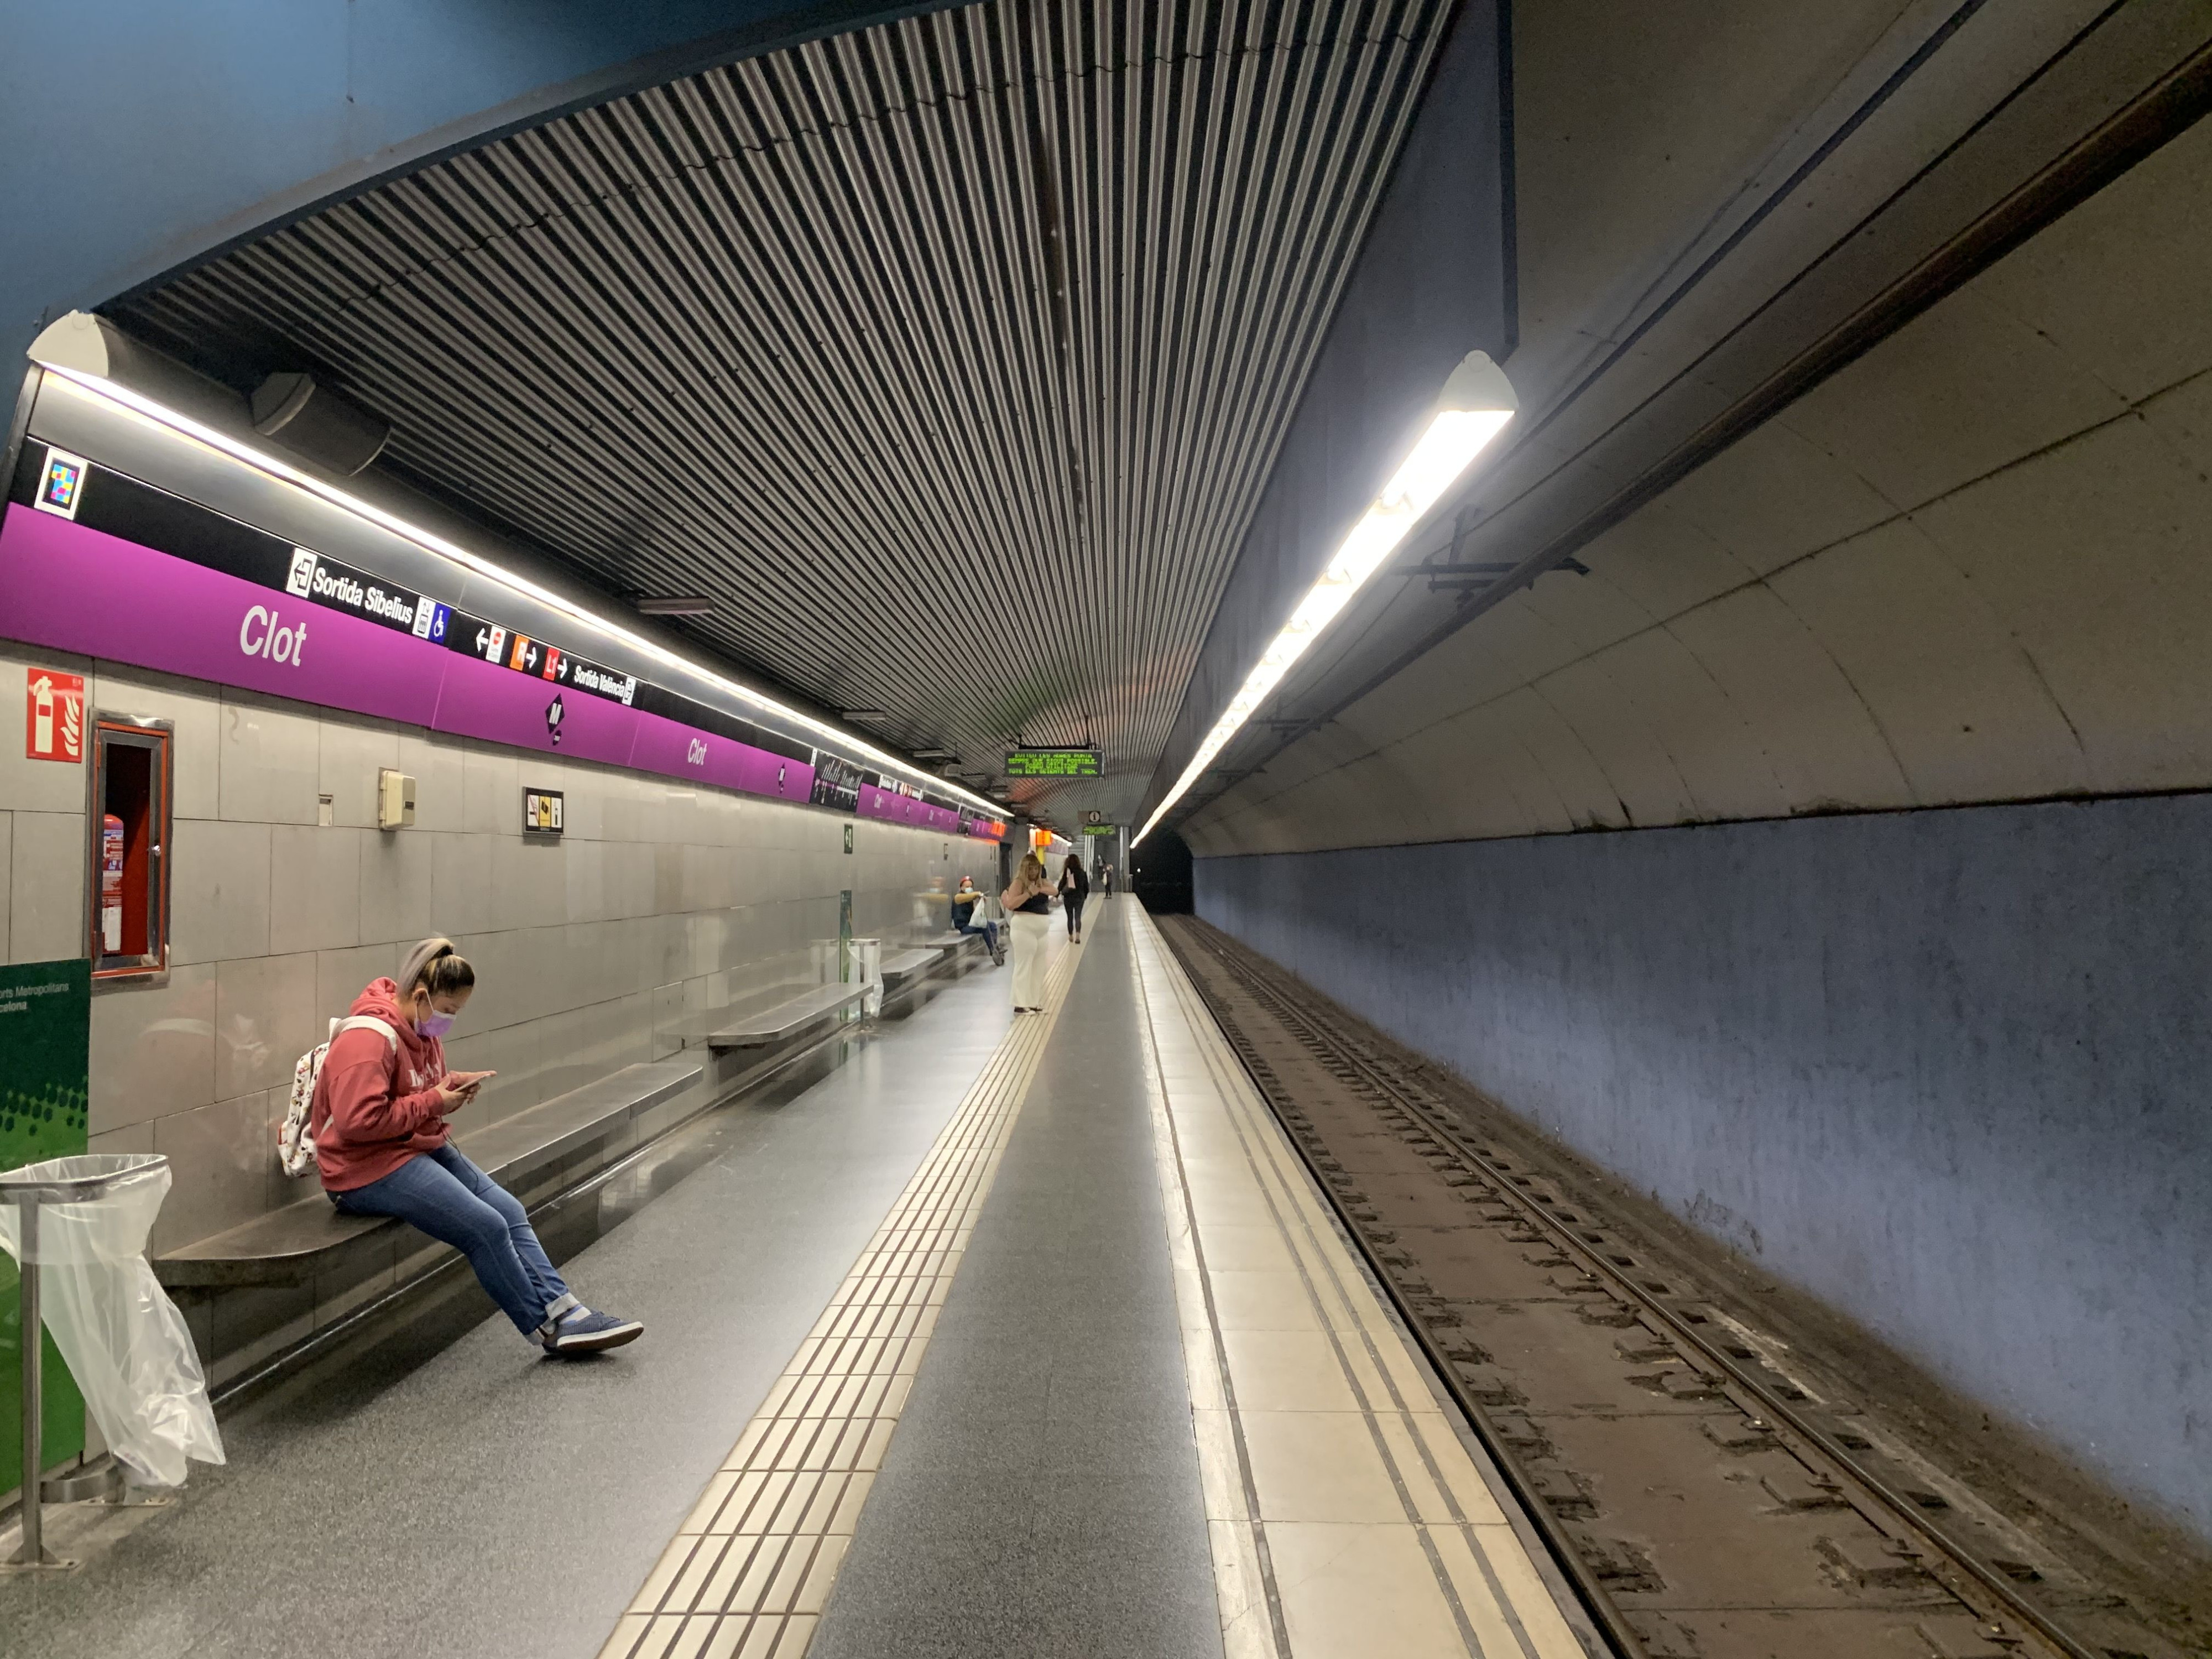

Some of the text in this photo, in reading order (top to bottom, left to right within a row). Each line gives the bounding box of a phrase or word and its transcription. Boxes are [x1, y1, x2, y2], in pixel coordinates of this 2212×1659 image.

[312, 567, 413, 624] Sortida Sibelius
[240, 604, 307, 667] Clot
[546, 655, 557, 674] L1
[574, 665, 625, 697] Sortida València
[549, 702, 562, 724] M
[687, 737, 707, 765] Clot
[15, 983, 69, 997] Metropolitans
